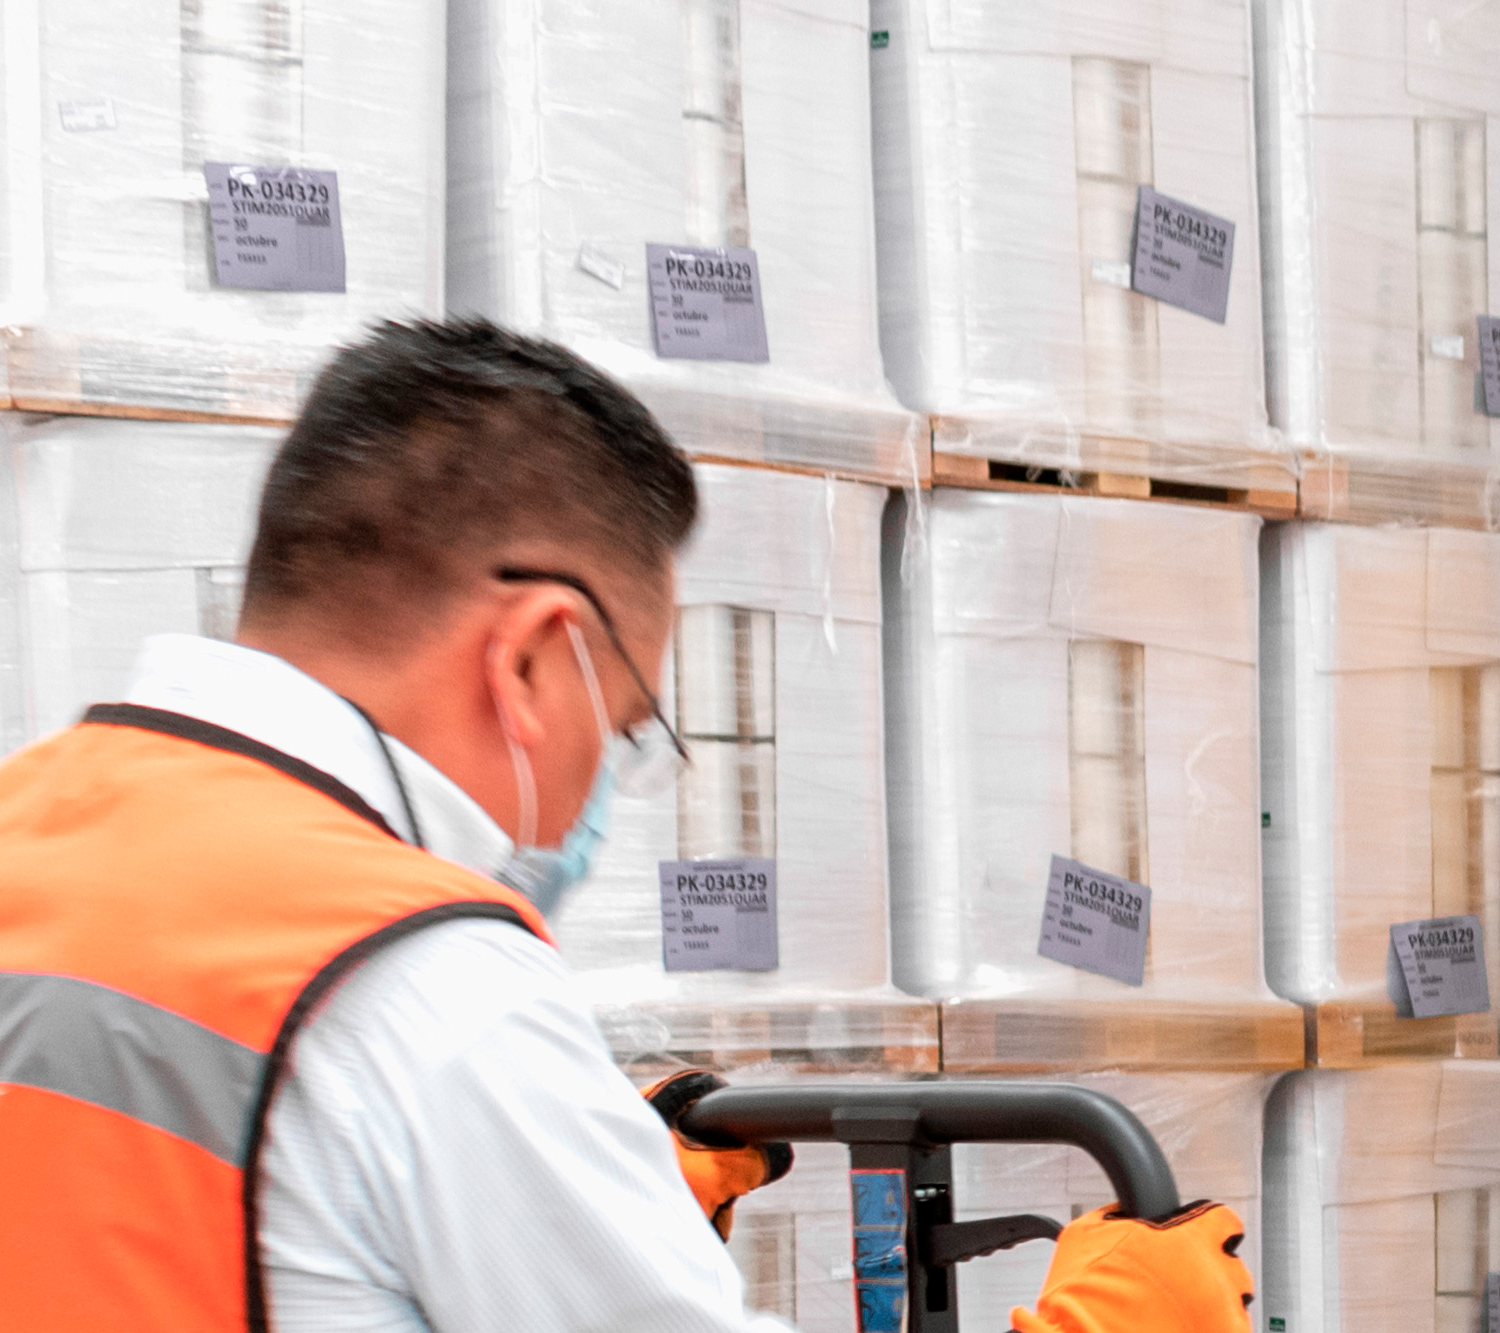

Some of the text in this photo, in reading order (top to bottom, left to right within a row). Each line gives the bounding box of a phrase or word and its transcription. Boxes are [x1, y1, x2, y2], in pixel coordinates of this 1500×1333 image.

[227, 178, 329, 205] PK-034329
[665, 257, 751, 280] PK-034329
[677, 872, 767, 892] PK-034329
[1063, 871, 1142, 912] PK-034329
[681, 922, 719, 935] octubre
[1408, 926, 1475, 950] PK-034329
